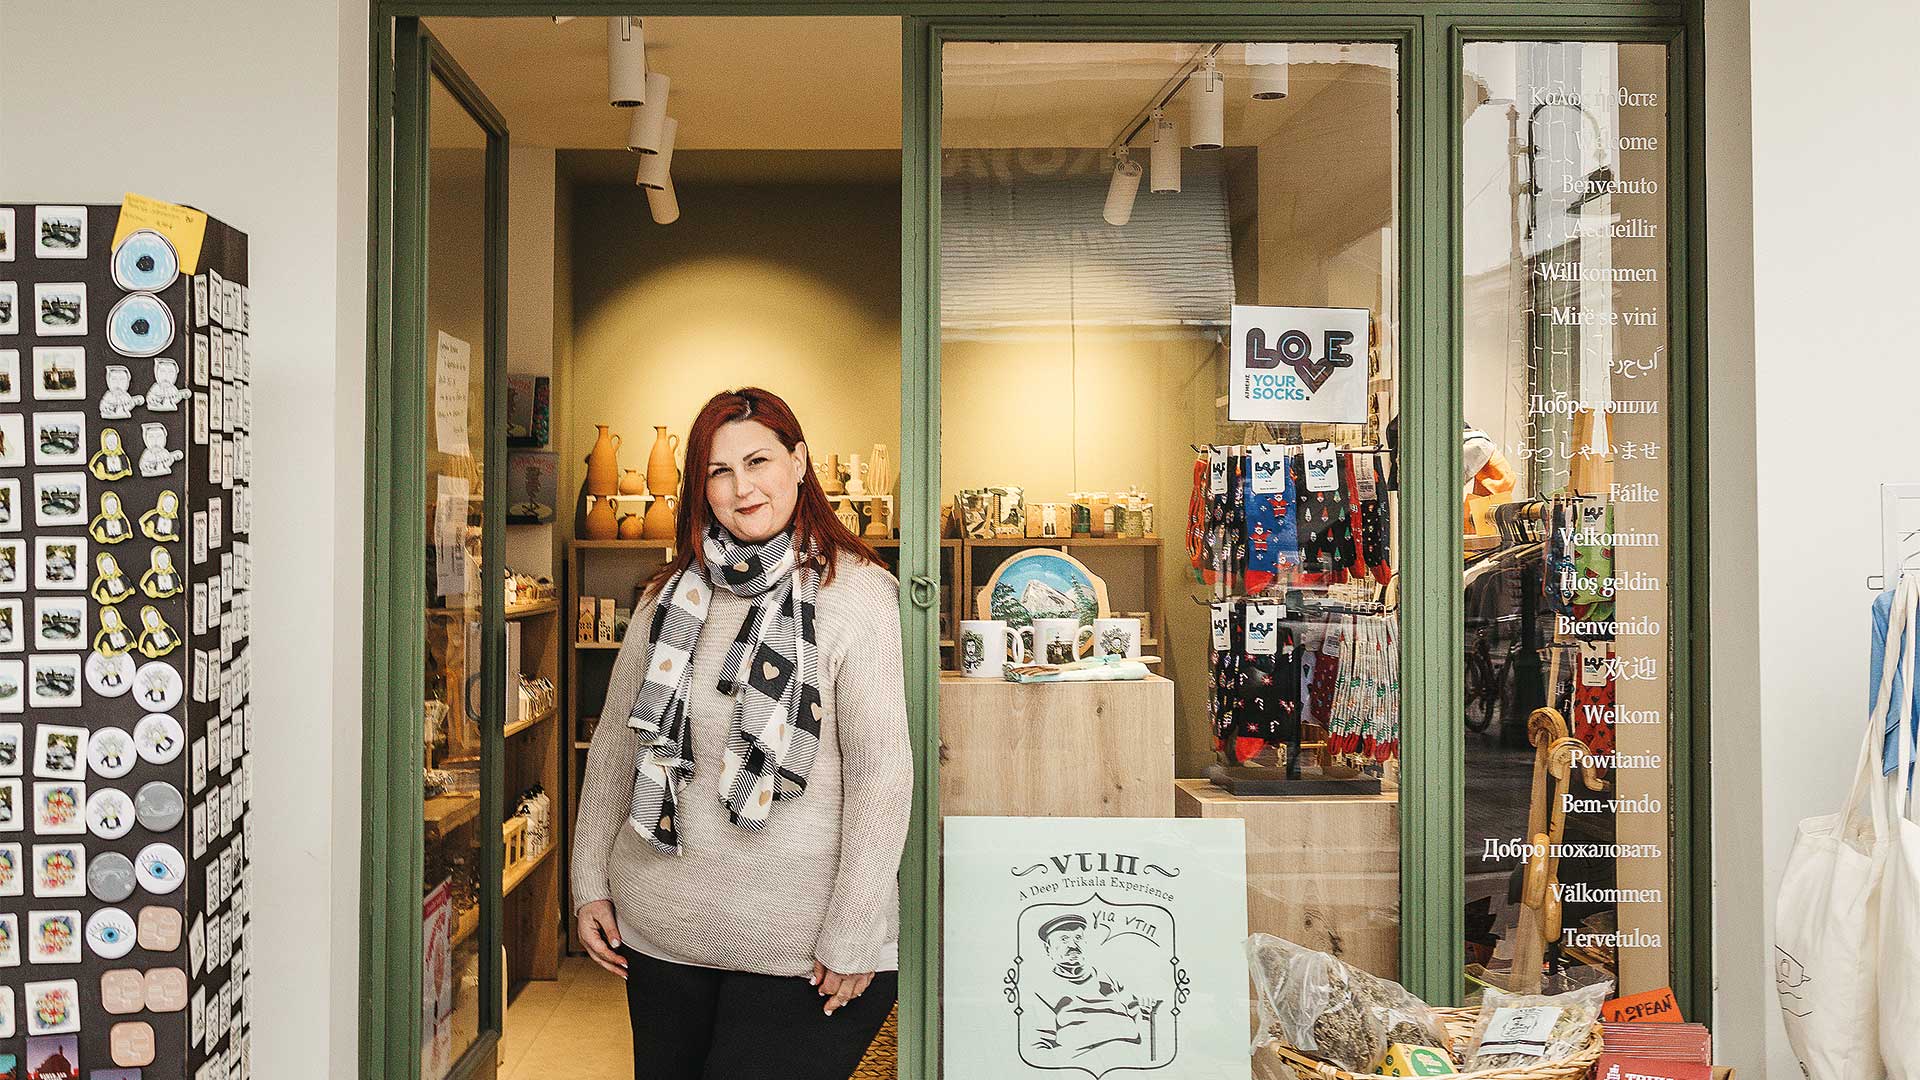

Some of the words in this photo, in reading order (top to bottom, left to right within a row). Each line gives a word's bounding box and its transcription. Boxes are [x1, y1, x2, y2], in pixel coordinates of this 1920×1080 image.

[1531, 86, 1590, 107] Καλώ
[1597, 86, 1657, 112] ρθατε
[1562, 175, 1657, 194] Benvenuto
[1572, 219, 1657, 238] Accueillir
[1541, 262, 1657, 281] Willkommen
[1552, 307, 1593, 325] Mirë
[1622, 307, 1657, 325] vini
[1246, 328, 1354, 394] LOVE
[1253, 375, 1296, 387] YOUR
[1253, 388, 1310, 401] SOCKS.
[1529, 394, 1589, 419] Добре
[1592, 400, 1658, 416] ошли
[1609, 482, 1659, 502] Fáilte
[1558, 528, 1660, 547] Velkominn
[1559, 571, 1598, 594] Hoş
[1602, 571, 1660, 597] geldin
[1558, 616, 1660, 635] Bienvenido
[1602, 656, 1658, 681] 欢迎
[1583, 705, 1660, 724] Welkom
[1569, 749, 1661, 769] Powitanie
[1561, 793, 1661, 813] Bem-vindo
[1482, 838, 1545, 864] Добро
[1549, 844, 1661, 858] пожаловать
[1019, 890, 1028, 901] A
[1030, 882, 1059, 896] Deep
[1062, 876, 1106, 888] Trikala
[1111, 877, 1175, 901] Experience
[1550, 883, 1662, 903] Välkommen
[1092, 910, 1116, 929] για
[1563, 928, 1662, 948] Tervetuloa
